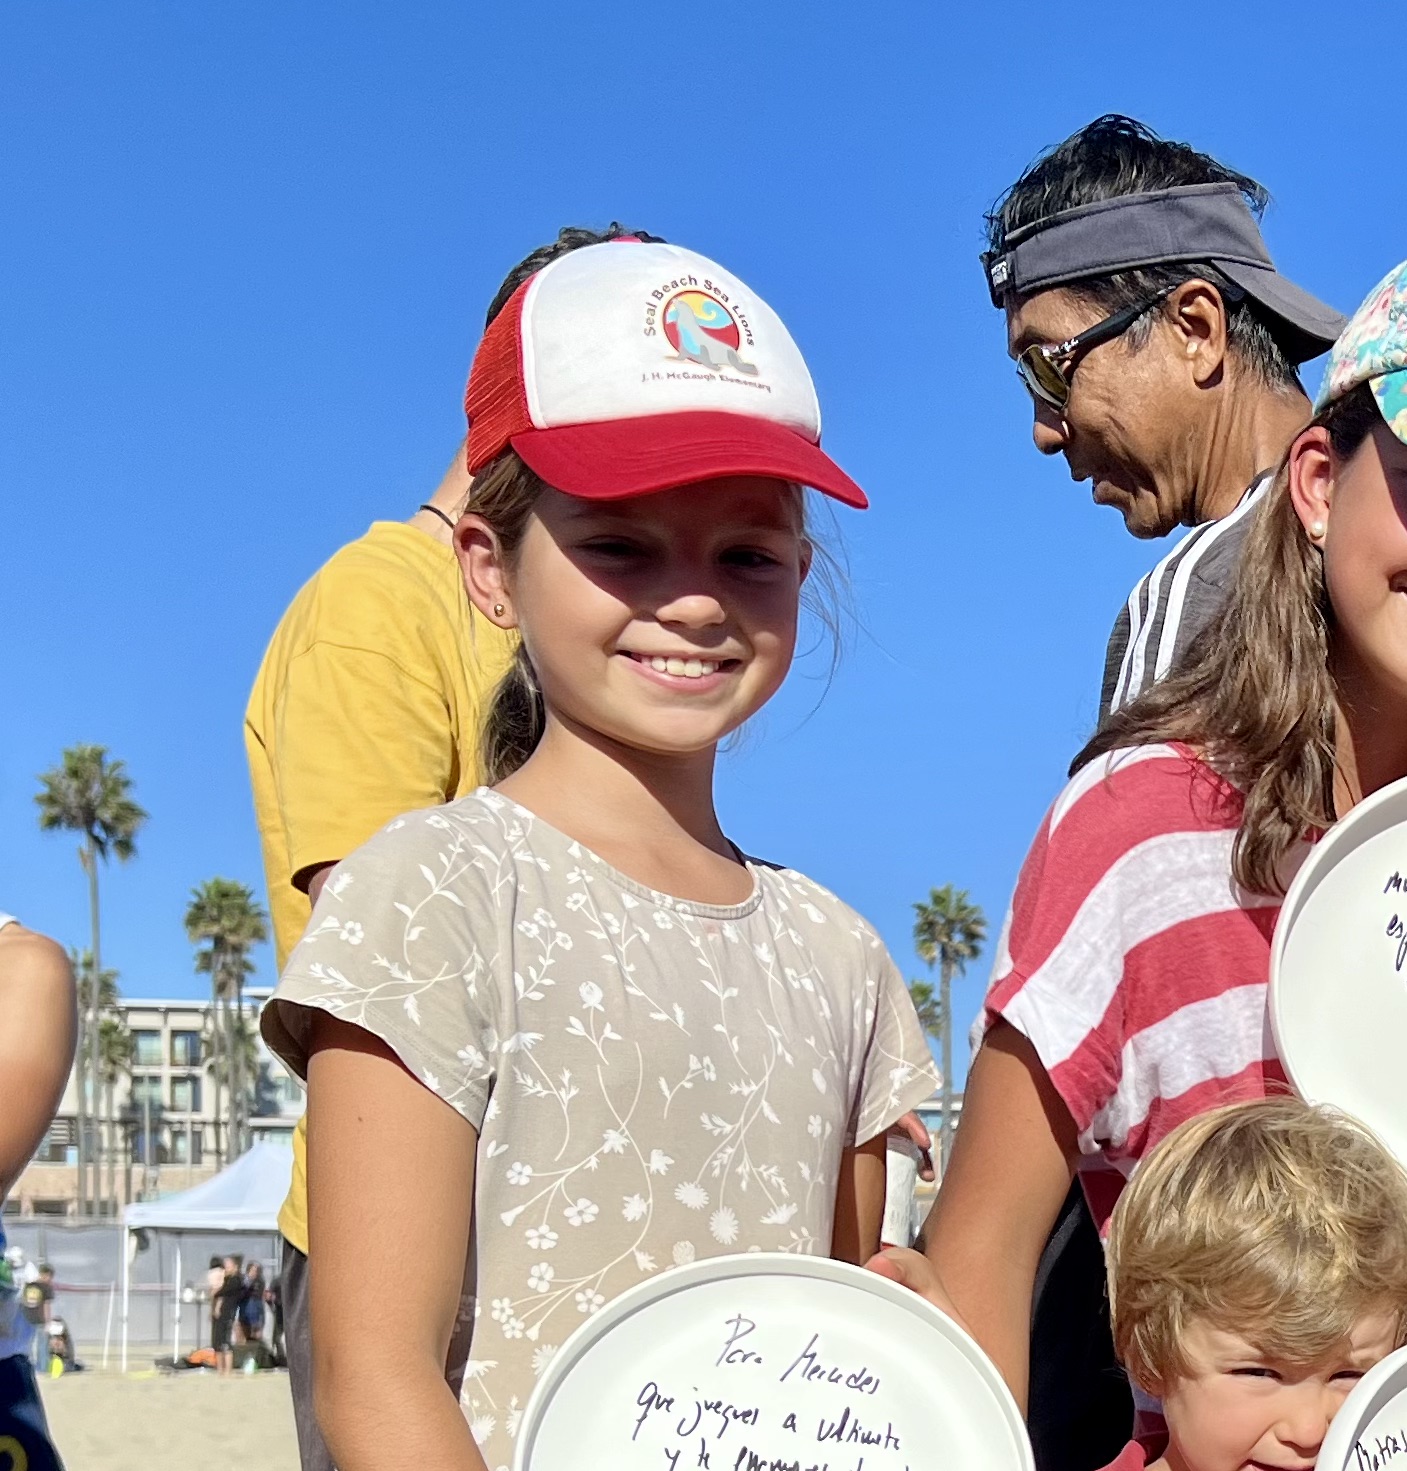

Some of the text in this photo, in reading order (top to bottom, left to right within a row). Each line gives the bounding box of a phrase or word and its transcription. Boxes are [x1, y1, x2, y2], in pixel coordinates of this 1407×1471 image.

[643, 274, 755, 347] Seal Beach Sea Lions
